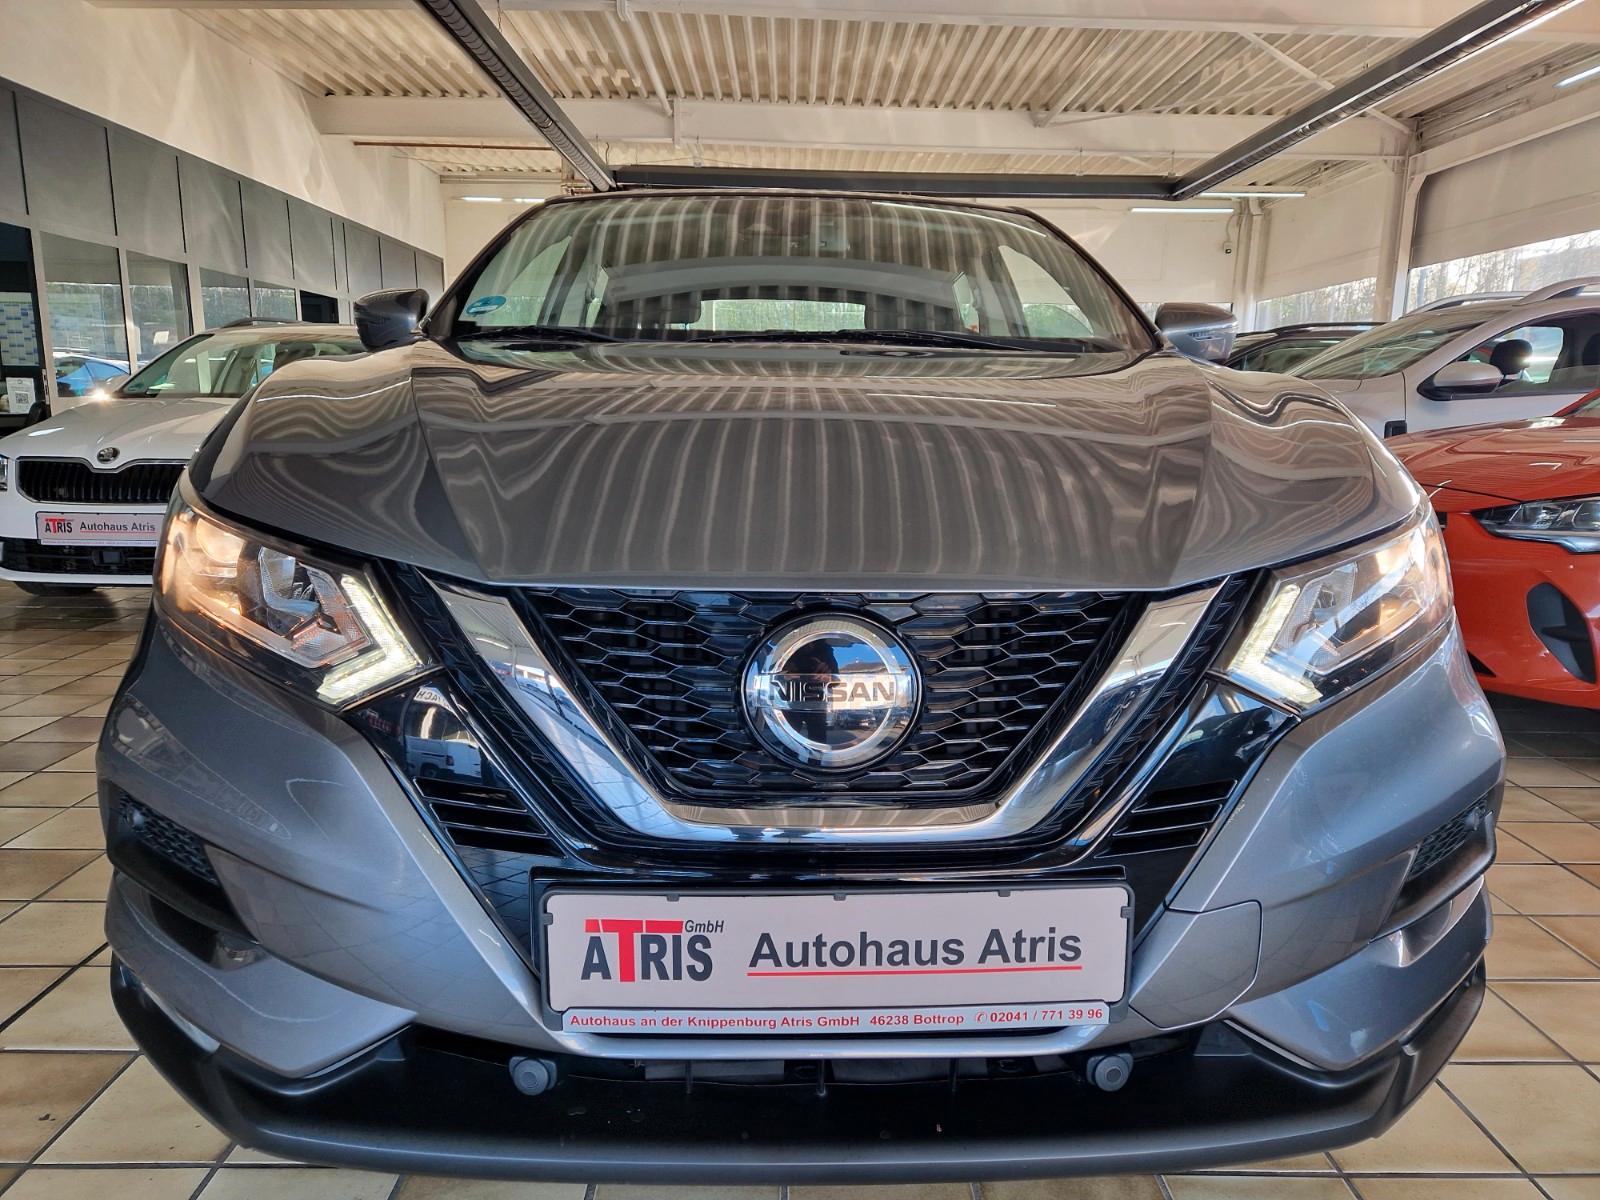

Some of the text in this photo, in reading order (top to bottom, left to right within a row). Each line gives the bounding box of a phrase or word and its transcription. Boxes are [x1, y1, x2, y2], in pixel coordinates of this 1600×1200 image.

[45, 517, 73, 533] ATRIS
[80, 522, 155, 531] Autohaus Atris
[769, 680, 895, 702] NISSAN
[684, 919, 724, 934] GmbH
[581, 919, 713, 982] ATRIS
[748, 927, 1082, 968] Autohaus Atris
[570, 1015, 636, 1027] Autohaus
[640, 1018, 657, 1027] an
[661, 1016, 683, 1027] der
[687, 1016, 777, 1030] Knippenburg
[780, 1016, 813, 1028] Atris
[817, 1015, 860, 1027] GmbH
[870, 1015, 909, 1026] 46238
[913, 1014, 965, 1026] Bottrop
[990, 1011, 1028, 1023] 02041
[1041, 1010, 1063, 1021] 771
[1068, 1009, 1083, 1020] 39
[1088, 1008, 1103, 1019] 96
